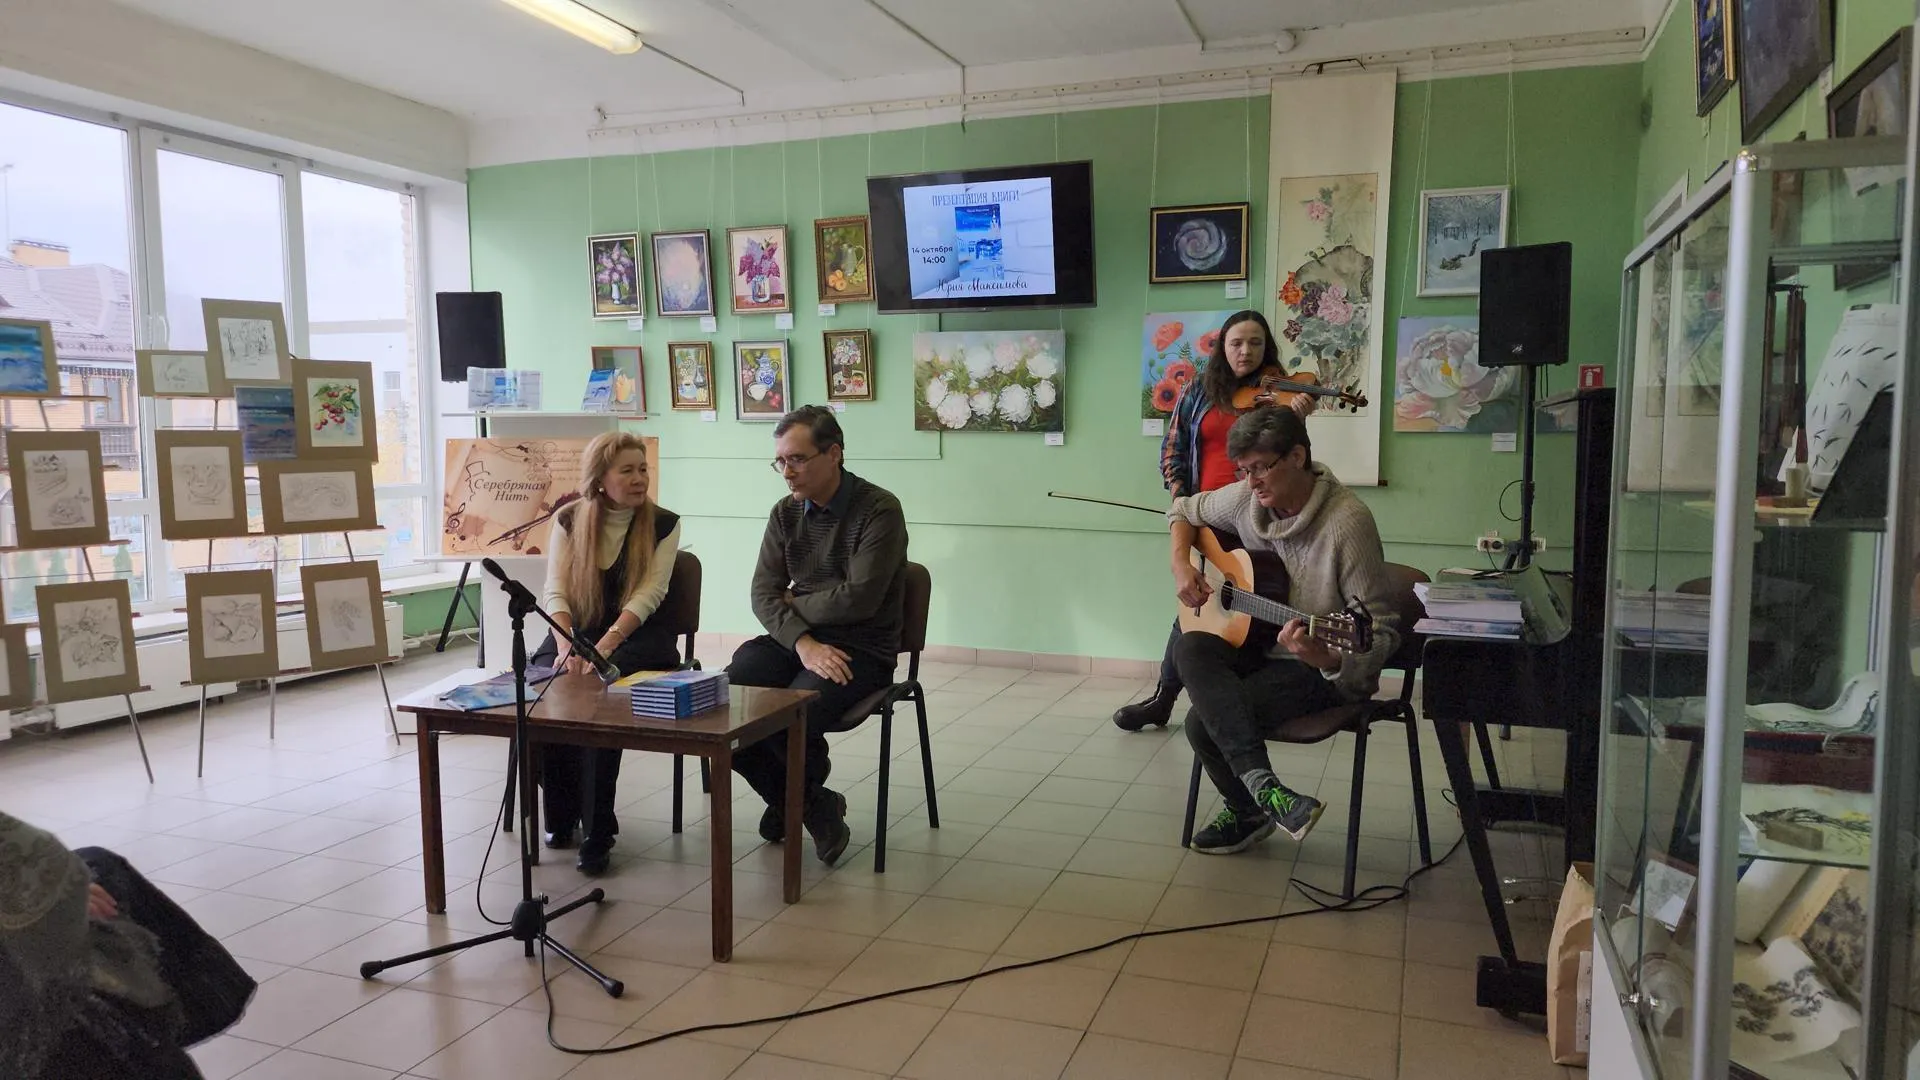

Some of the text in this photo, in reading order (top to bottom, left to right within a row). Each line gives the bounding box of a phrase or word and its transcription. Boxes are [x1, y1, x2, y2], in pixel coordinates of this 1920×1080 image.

[932, 189, 1020, 206] ПРЕЗЕНТАЦИЯ КНИГИ
[921, 245, 953, 254] октября
[922, 256, 946, 264] 14:00
[967, 275, 1028, 293] Максимова
[474, 478, 547, 493] Серебряная
[494, 490, 530, 502] Нить
